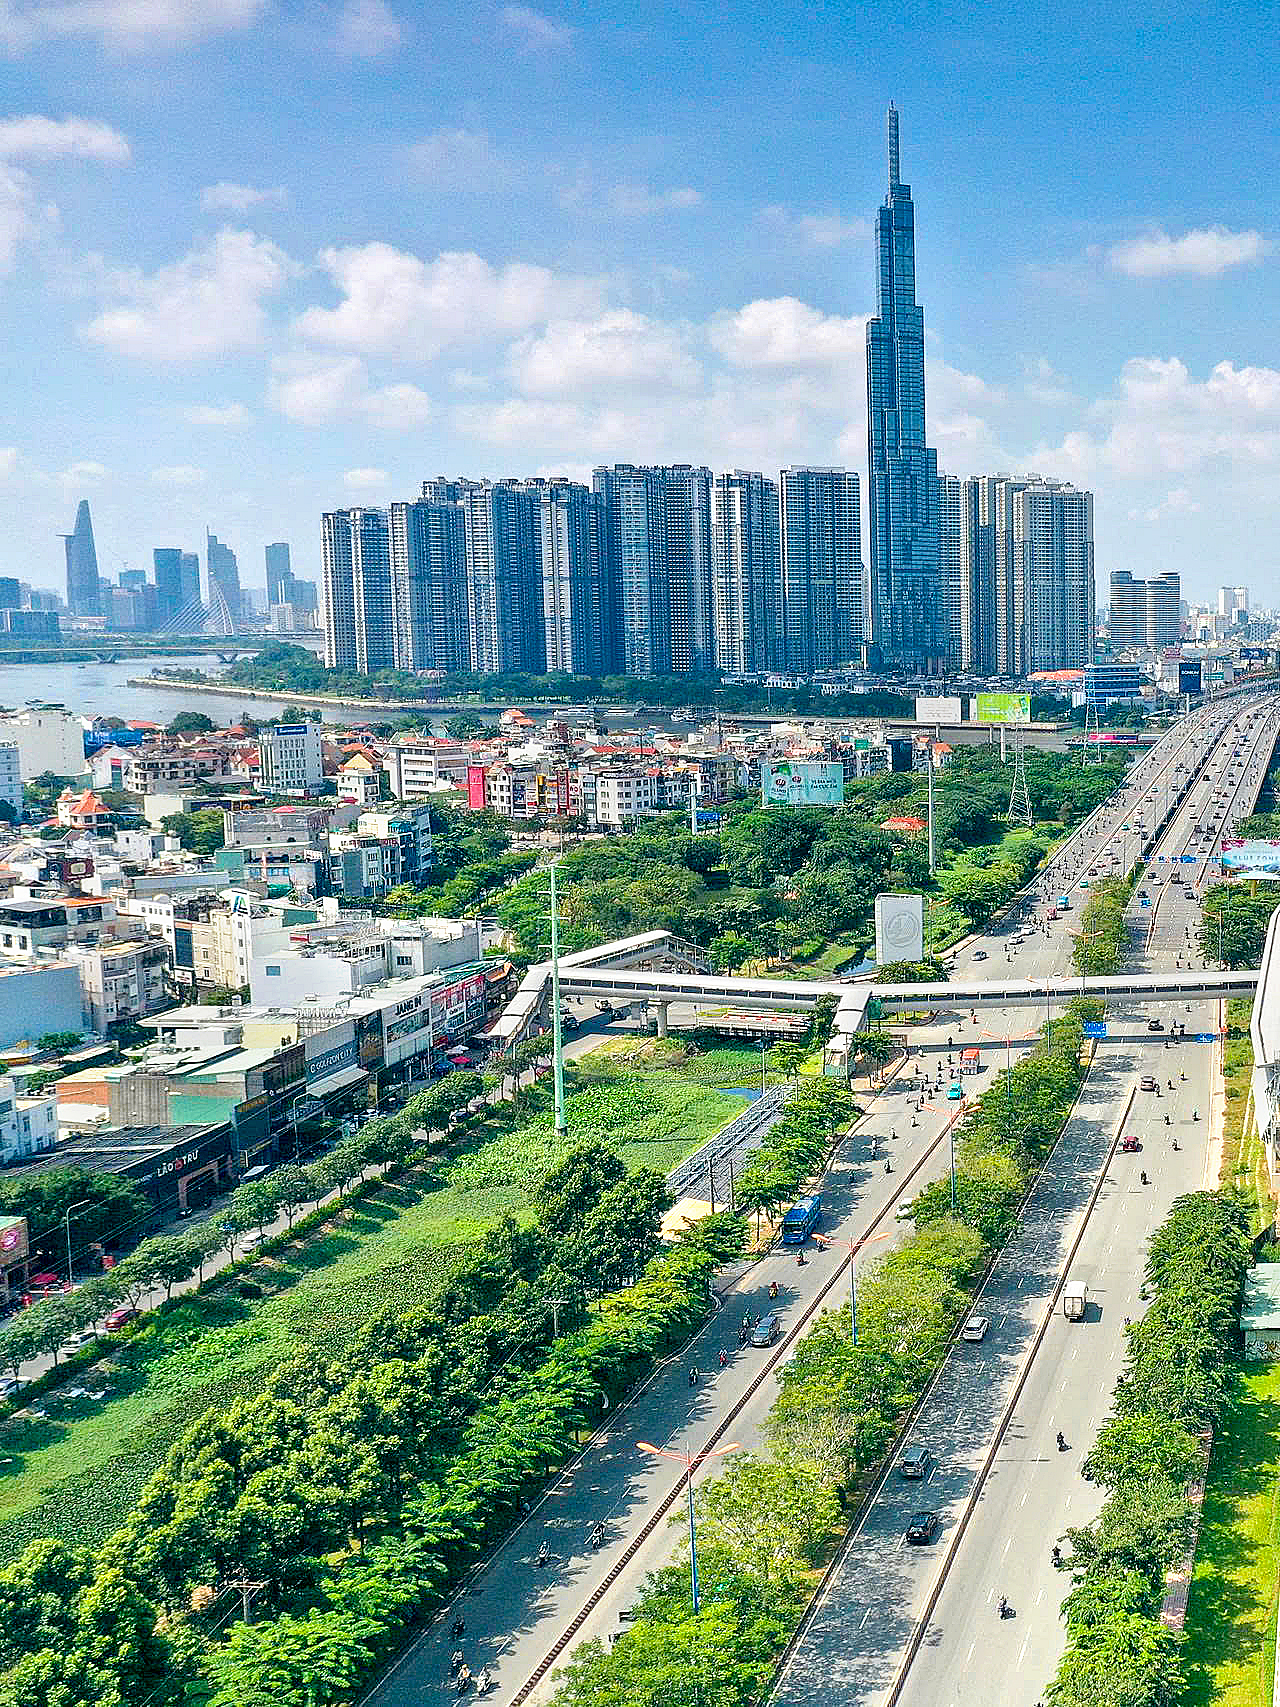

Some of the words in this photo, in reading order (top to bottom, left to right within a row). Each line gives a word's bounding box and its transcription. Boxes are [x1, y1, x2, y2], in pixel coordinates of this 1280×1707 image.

[395, 1000, 413, 1015] JANG
[414, 996, 422, 1007] IN
[157, 1162, 174, 1177] LÃO
